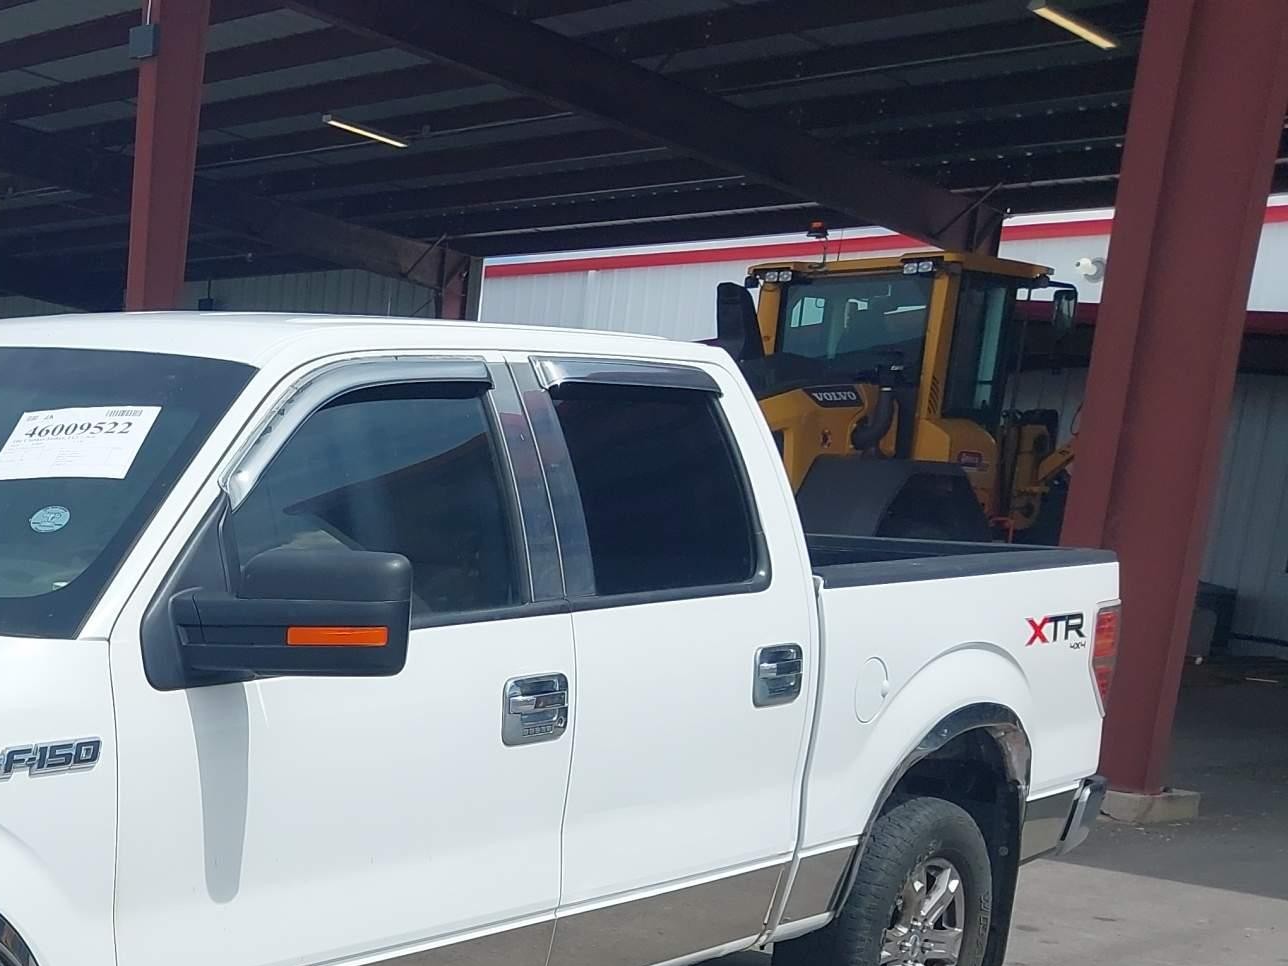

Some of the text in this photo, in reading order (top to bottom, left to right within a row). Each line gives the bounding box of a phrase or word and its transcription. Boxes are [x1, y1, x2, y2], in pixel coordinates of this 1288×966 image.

[813, 391, 857, 401] VOLVO
[24, 421, 133, 438] 46009522
[1024, 613, 1086, 647] XTR
[0, 737, 101, 777] F-150
